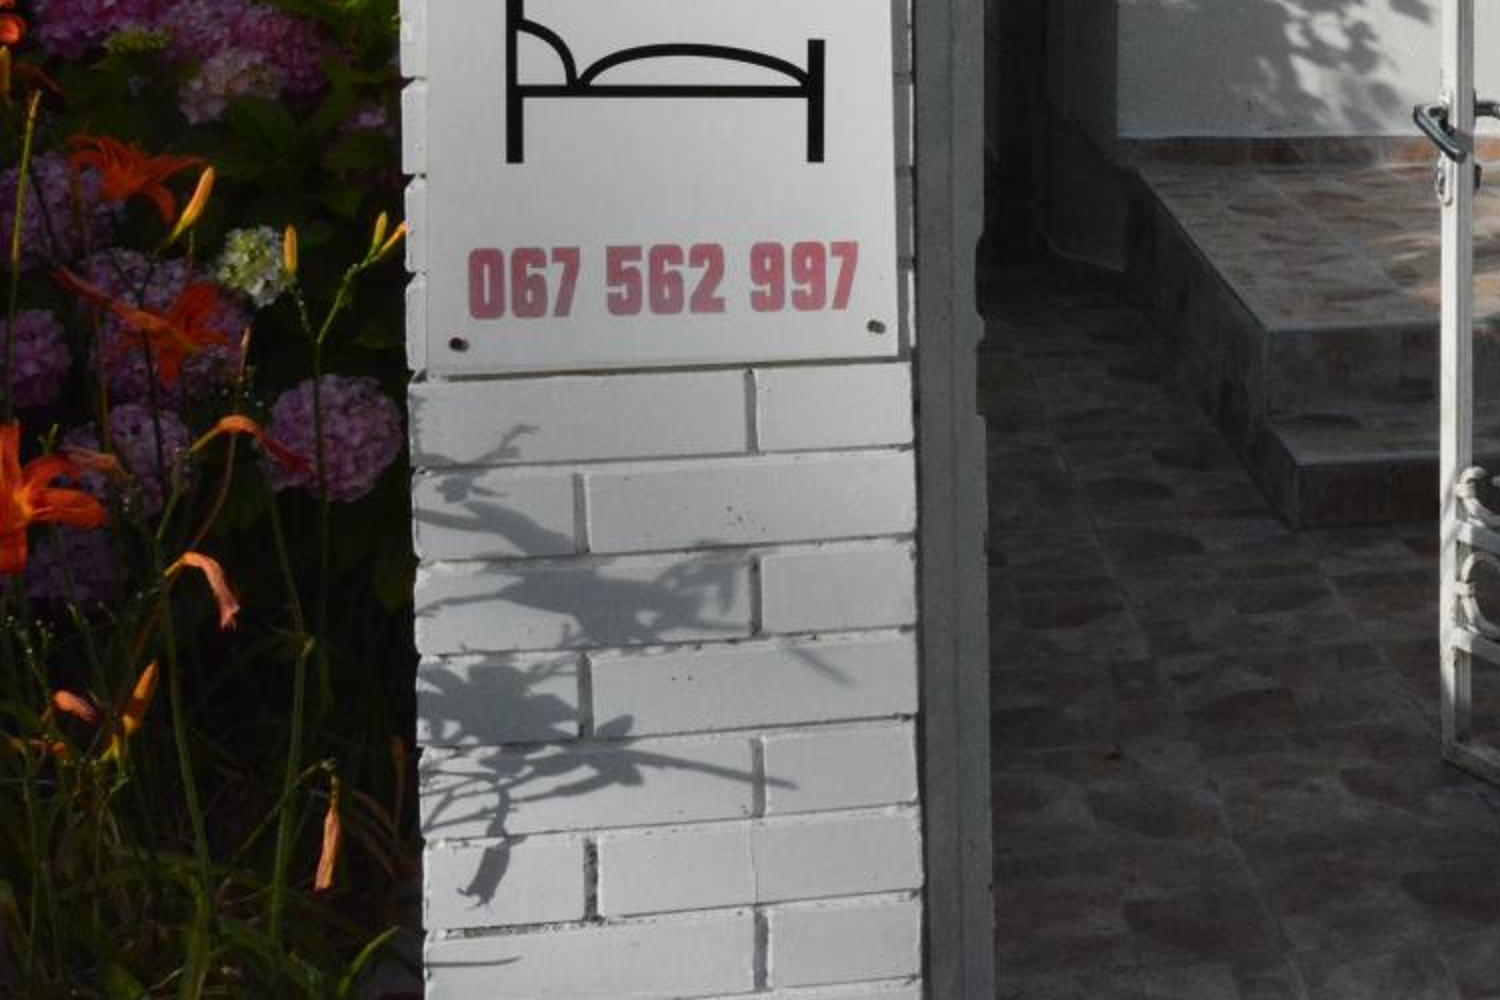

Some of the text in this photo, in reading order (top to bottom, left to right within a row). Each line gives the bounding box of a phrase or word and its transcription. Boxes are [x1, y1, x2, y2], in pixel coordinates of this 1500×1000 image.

[468, 240, 859, 319] 067 562 997
